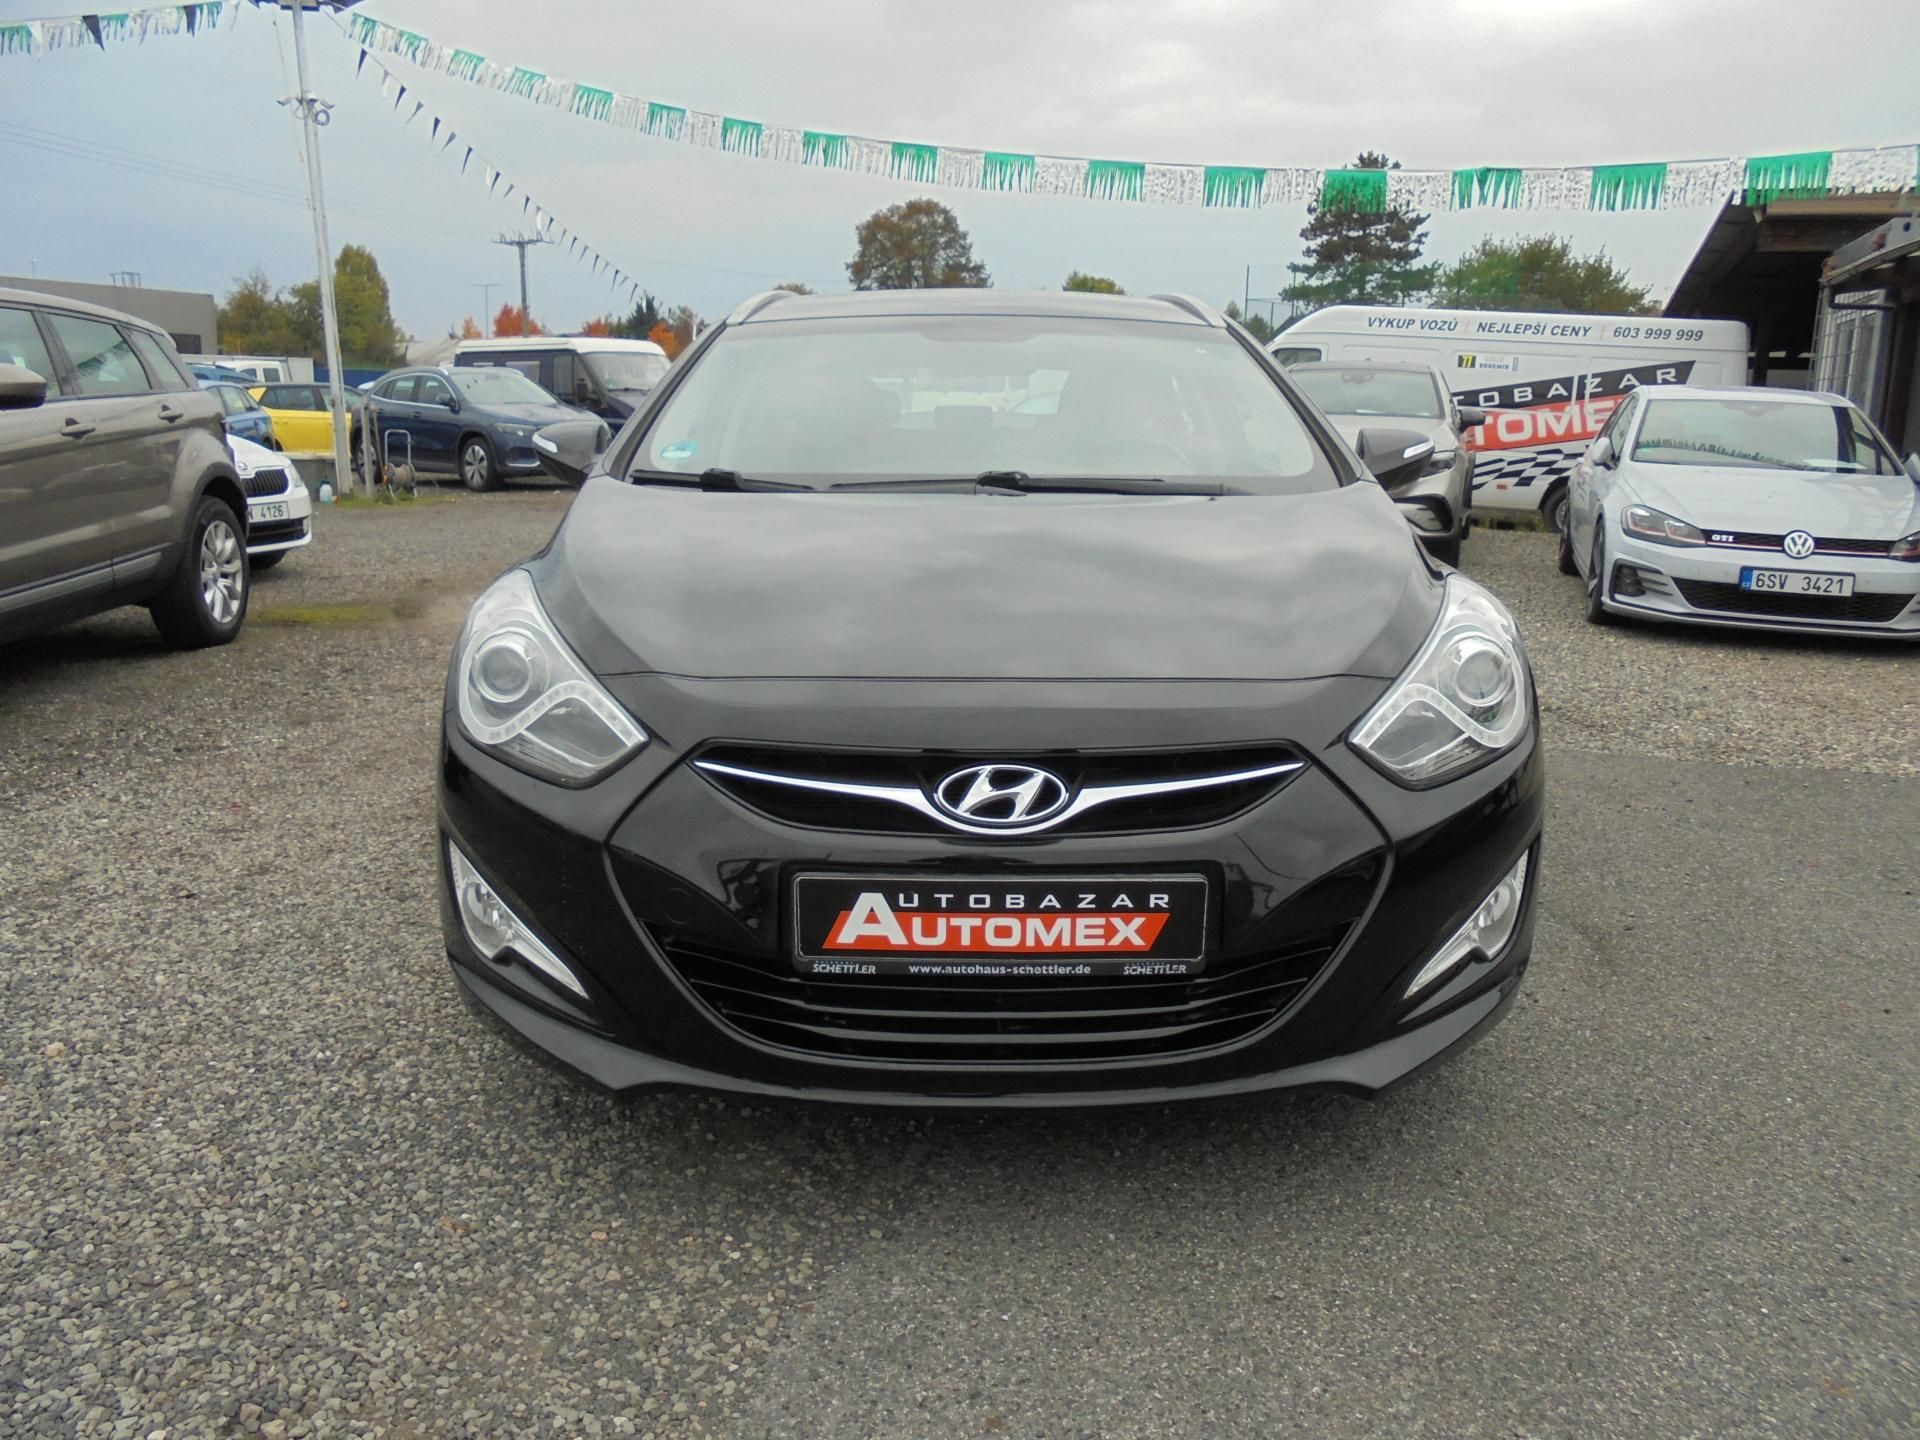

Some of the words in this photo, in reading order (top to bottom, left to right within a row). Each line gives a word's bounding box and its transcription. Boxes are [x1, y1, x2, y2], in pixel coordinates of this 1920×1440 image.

[1367, 316, 1415, 330] VÝKUP
[1419, 317, 1458, 332] VOZŮ
[1476, 319, 1547, 336] NEJLEPŠÍ
[1550, 325, 1592, 338] CENY
[1613, 326, 1640, 339] 603
[1643, 327, 1671, 341] 999
[1675, 328, 1704, 342] 999
[1474, 396, 1622, 446] TOME
[260, 504, 284, 519] 4126
[1711, 533, 1734, 542] GTI
[1755, 572, 1789, 590] 6SV
[1801, 576, 1845, 594] 3421
[836, 892, 1146, 947] AUTOMEX
[812, 963, 876, 975] SCHETTLER
[908, 963, 1091, 976] www.autohaus-schettler.de
[1123, 964, 1187, 975] SCHETTLER
